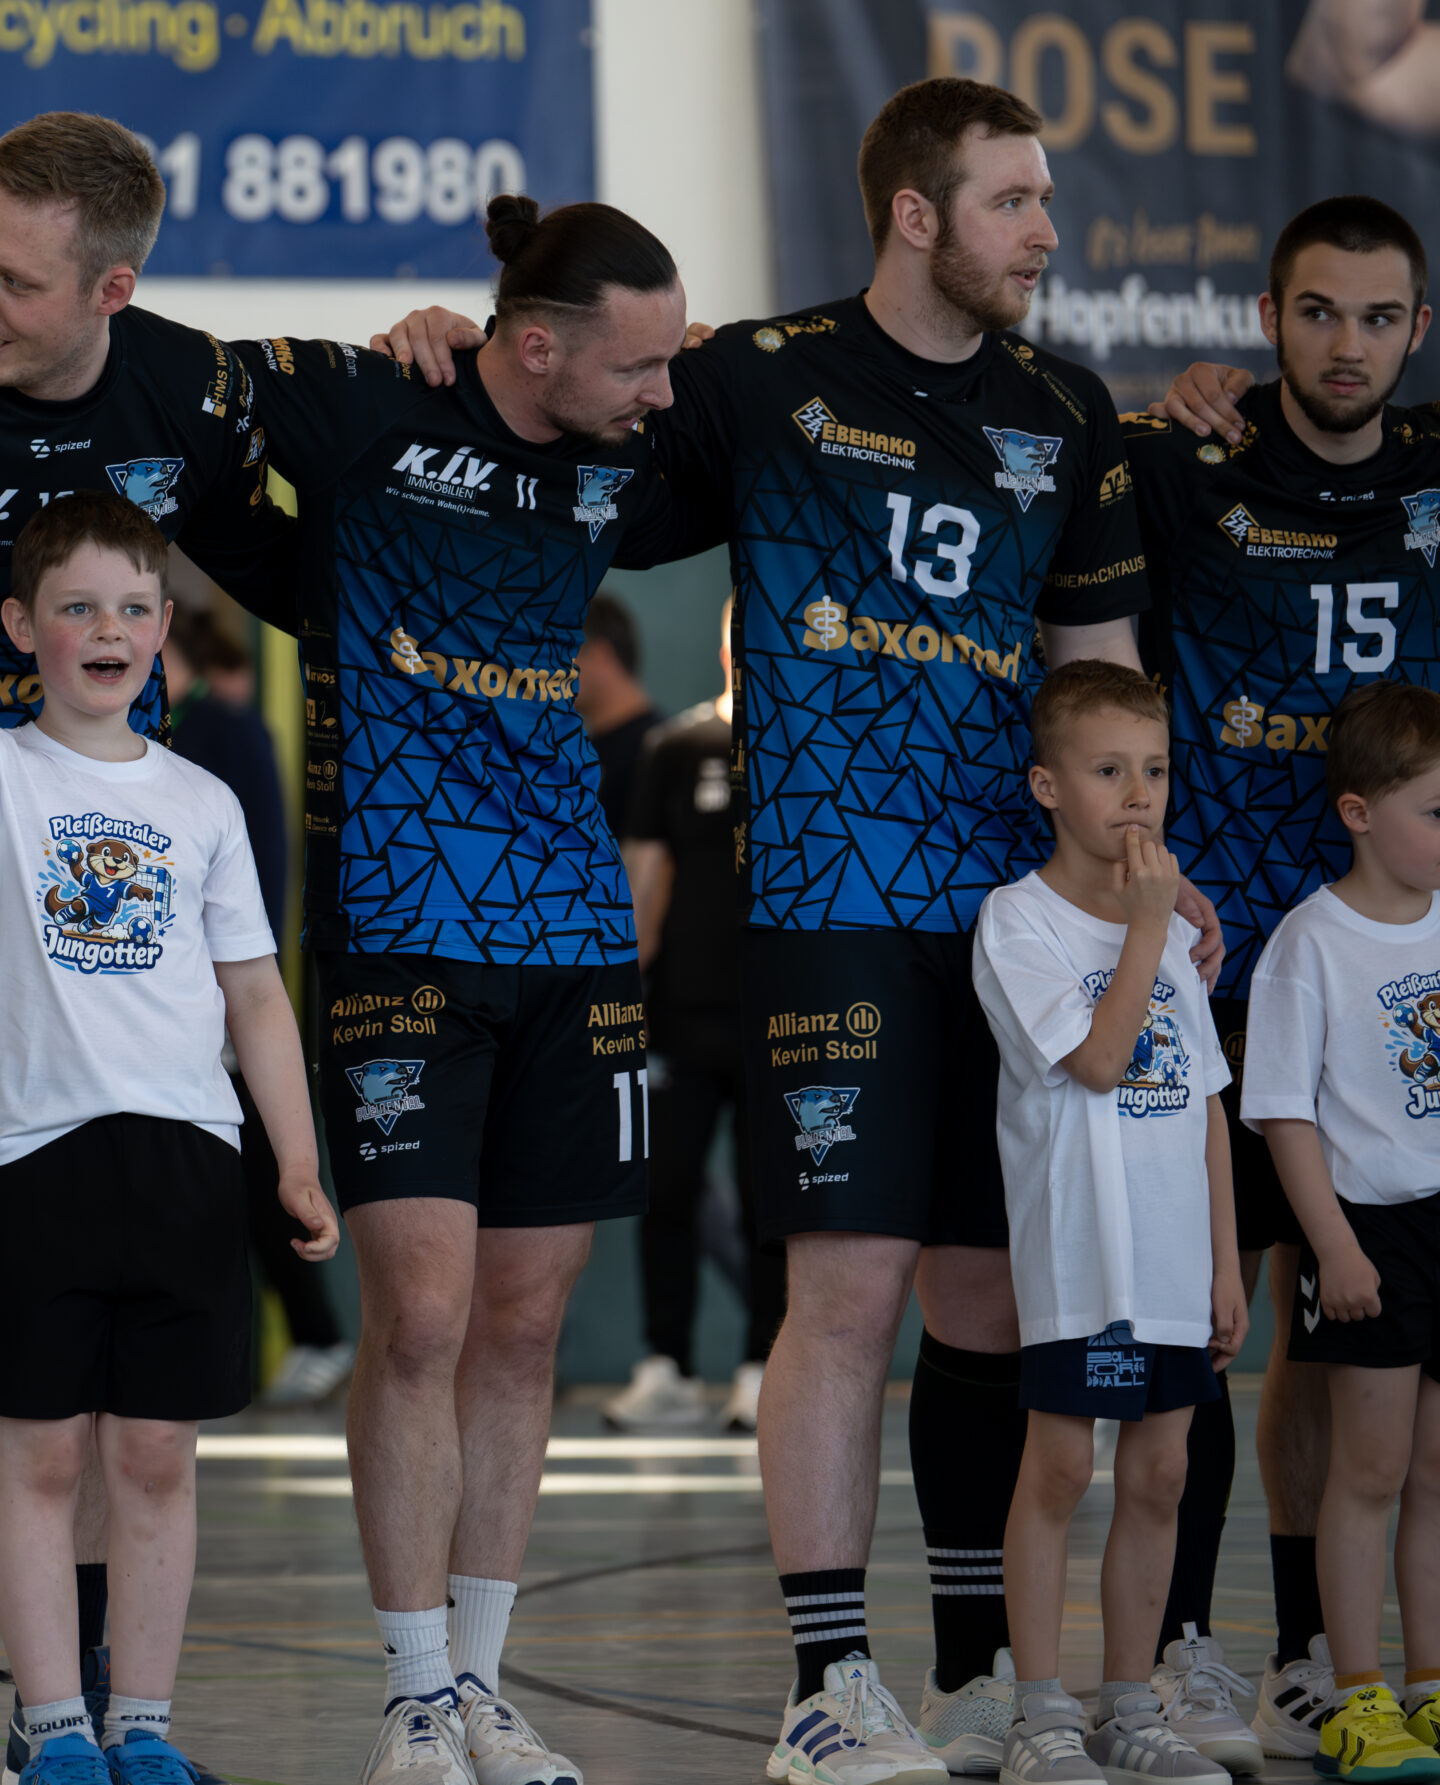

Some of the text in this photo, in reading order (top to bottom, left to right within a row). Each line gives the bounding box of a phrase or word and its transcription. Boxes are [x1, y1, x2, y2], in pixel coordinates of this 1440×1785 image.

[254, 0, 526, 61] Abbruch
[224, 131, 527, 225] 881980
[54, 439, 92, 453] spized
[822, 421, 916, 458] EBEHAKO
[821, 442, 915, 471] ELEKTROTECHNIK
[385, 485, 401, 498] Wir
[401, 490, 435, 506] schaffen
[407, 475, 475, 500] IMMOBILIEN
[516, 473, 540, 511] 11
[886, 491, 981, 600] 13
[1247, 525, 1338, 548] EBEHAKO
[1246, 545, 1336, 560] ELEKTROTECHNIK
[1310, 581, 1400, 674] 15
[49, 813, 171, 853] Pleißentaler
[43, 925, 163, 974] Jungotter
[330, 992, 405, 1020] Allianz
[587, 1001, 644, 1028] Allianz
[332, 1014, 437, 1046] Kevin Stoll
[767, 1012, 840, 1040] Allianz
[592, 1034, 635, 1056] Kevin
[771, 1039, 877, 1068] Kevin Stoll
[613, 1068, 649, 1163] 11
[1117, 1085, 1190, 1118] ngotter
[381, 1140, 421, 1154] spized
[812, 1172, 850, 1185] spized
